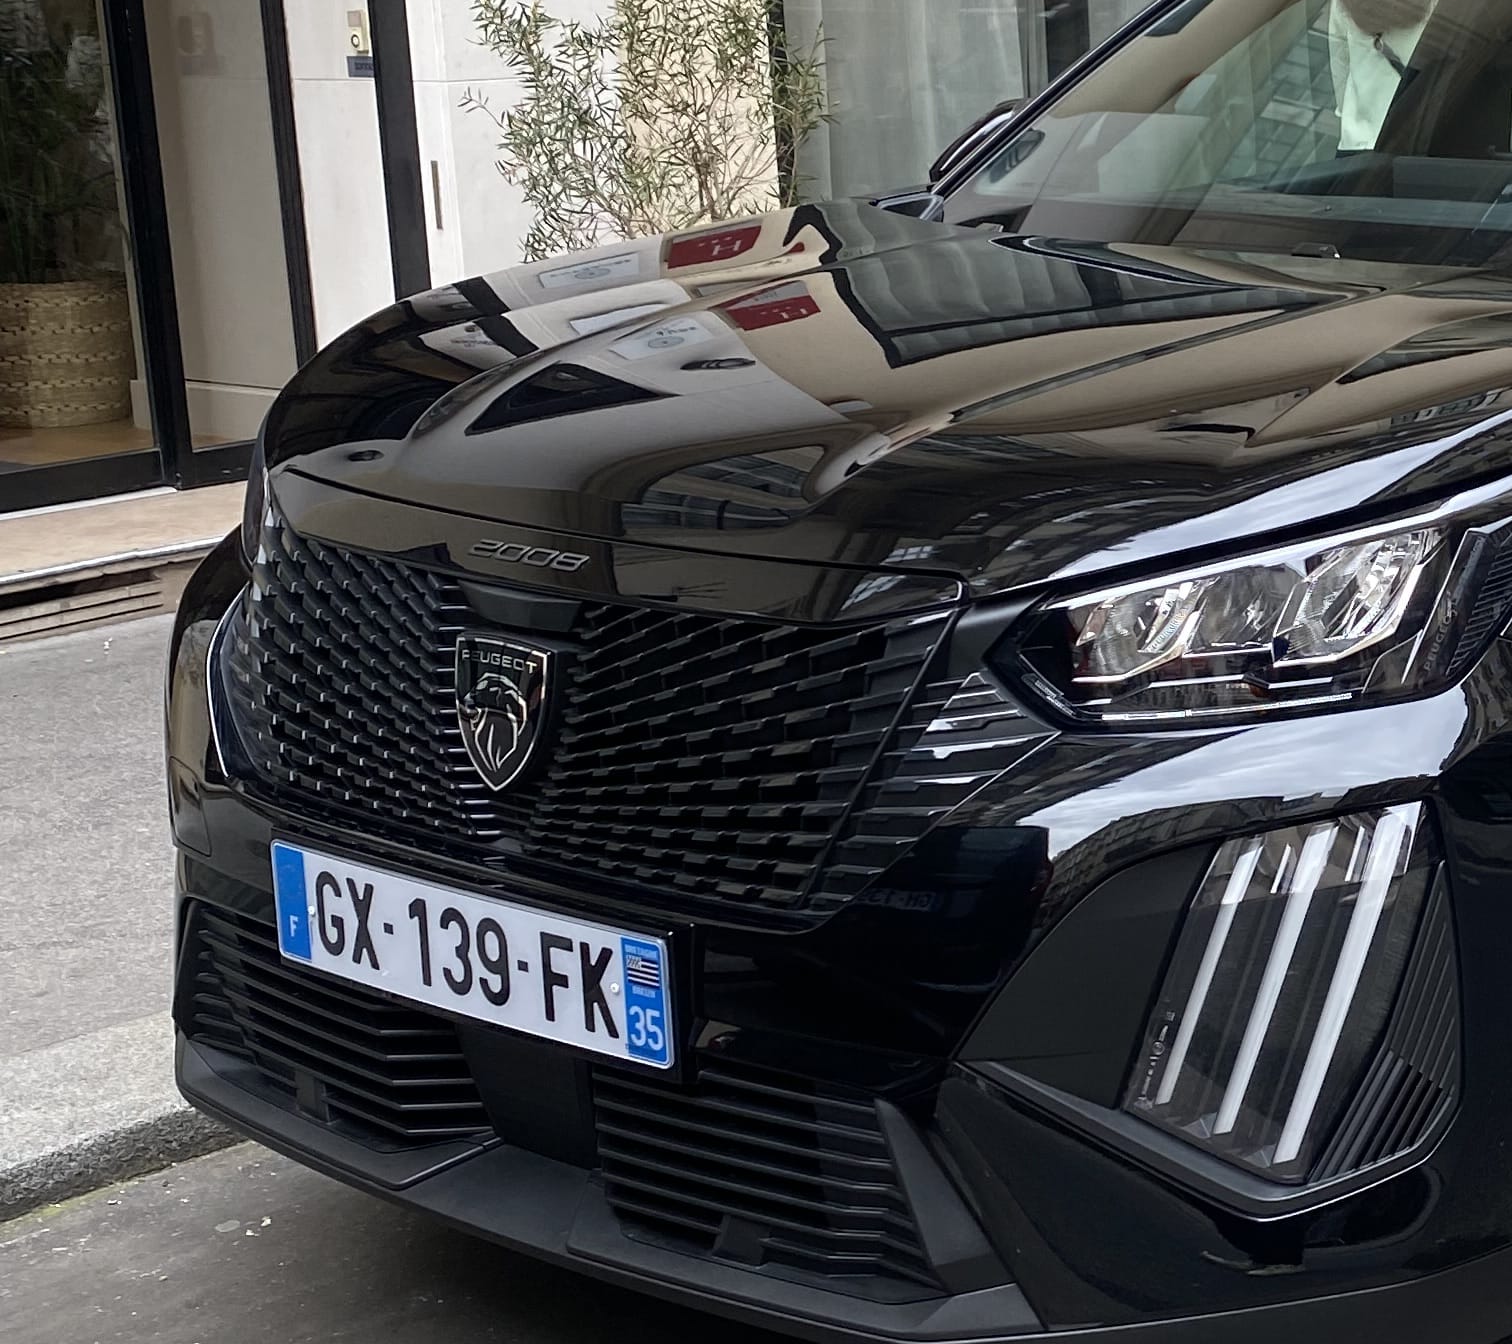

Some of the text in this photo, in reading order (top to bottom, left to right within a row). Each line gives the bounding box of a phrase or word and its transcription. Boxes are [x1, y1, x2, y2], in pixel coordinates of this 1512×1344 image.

[467, 538, 591, 573] 2008
[461, 649, 538, 674] PEUGEOT
[289, 915, 299, 938] F
[315, 870, 620, 1038] GX-139-FK
[628, 1005, 664, 1051] 35
